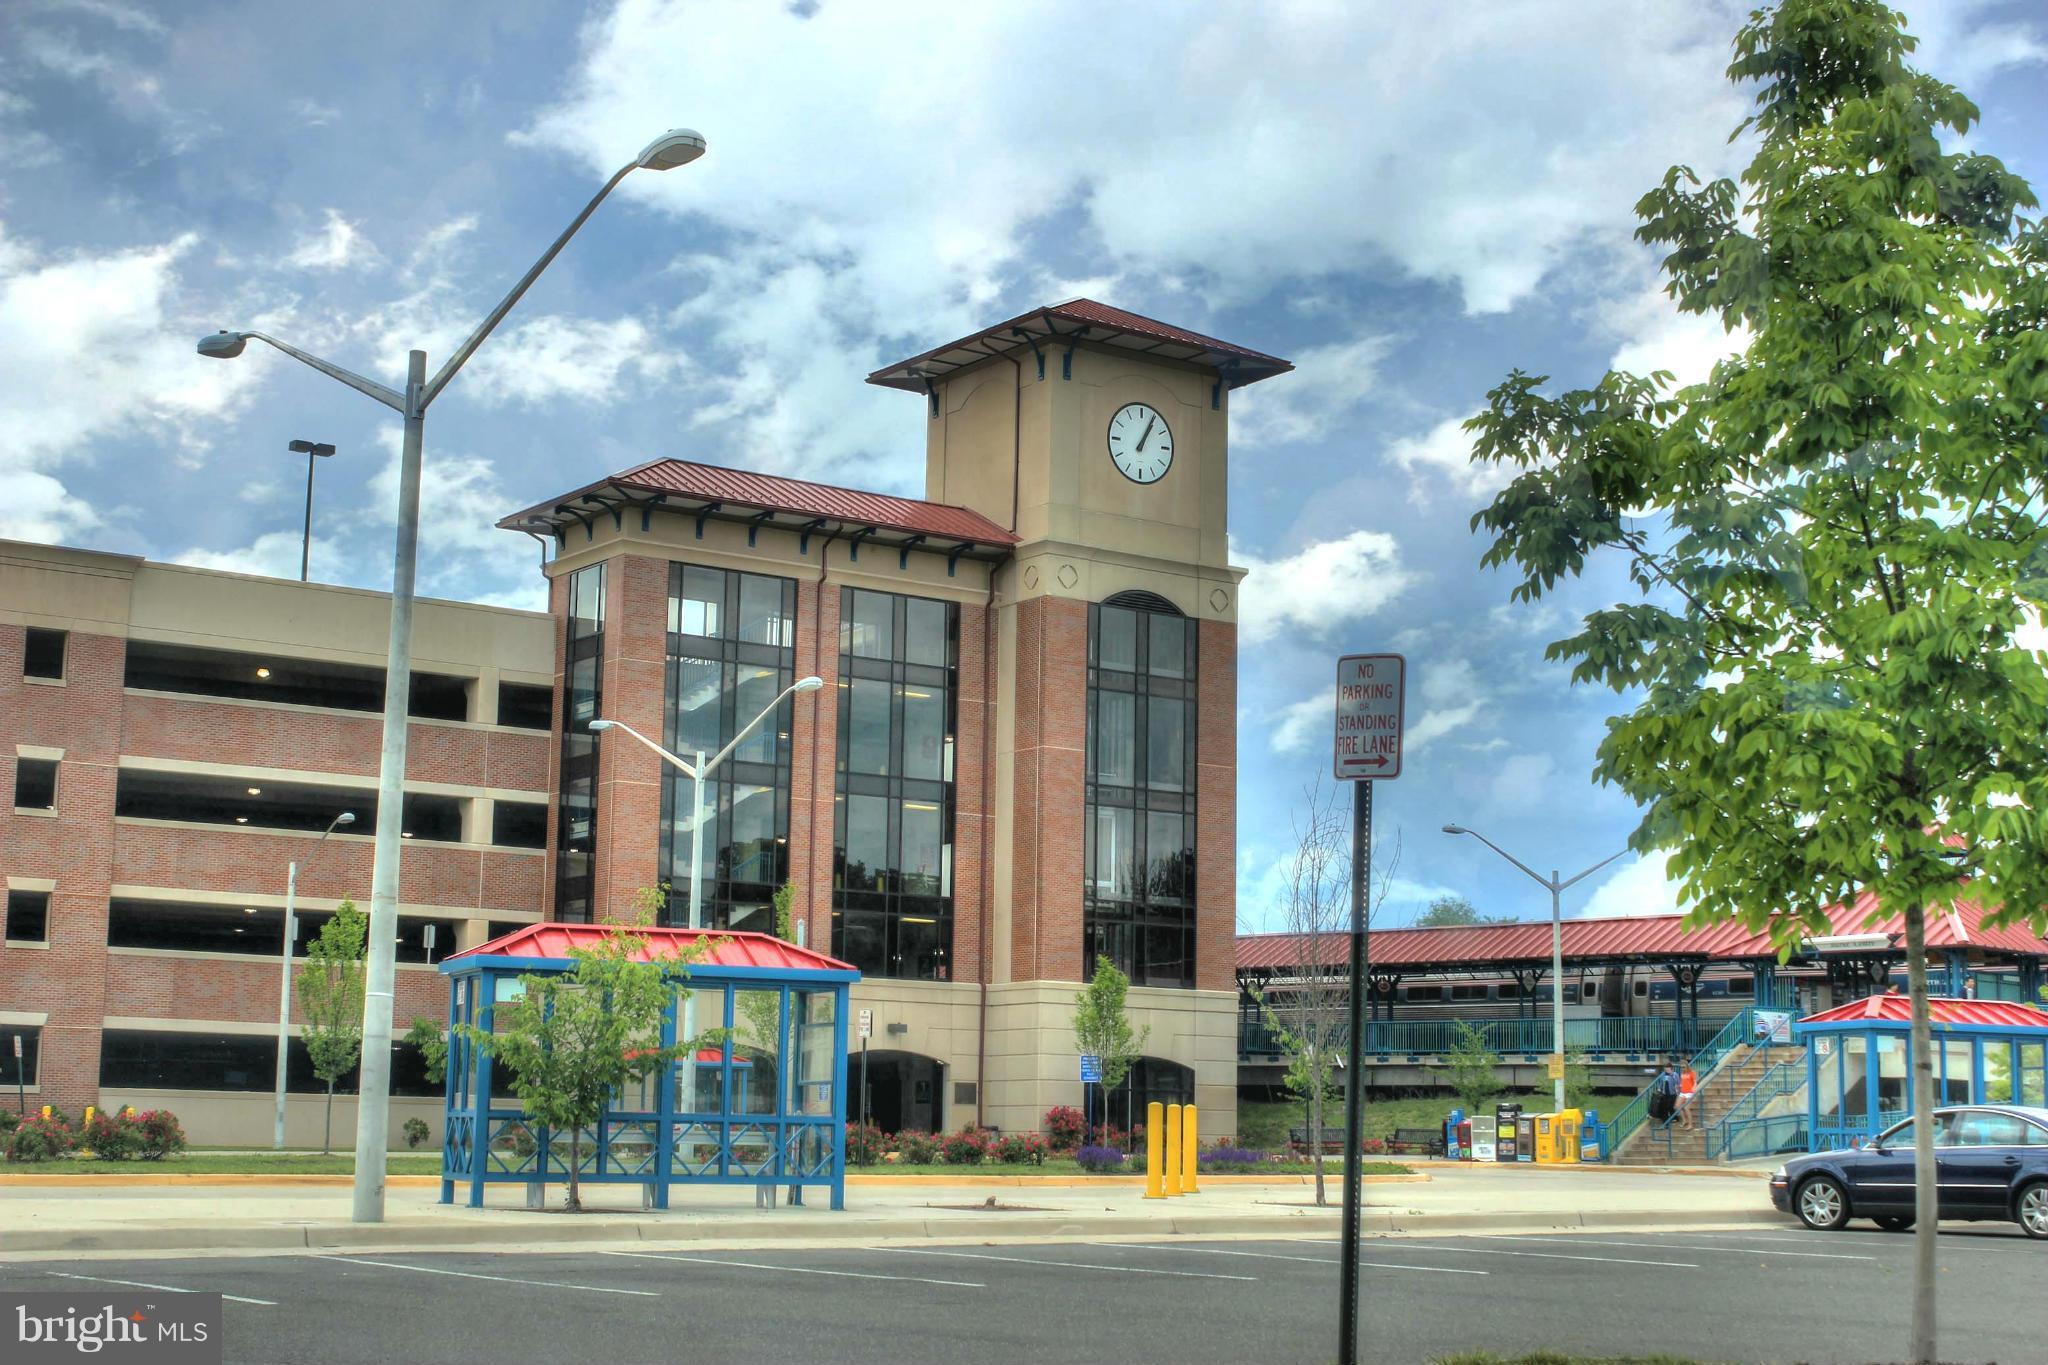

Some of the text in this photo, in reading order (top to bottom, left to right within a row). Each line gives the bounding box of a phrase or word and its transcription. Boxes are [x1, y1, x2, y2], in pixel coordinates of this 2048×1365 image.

[1358, 663, 1374, 679] NO
[1342, 683, 1393, 701] PARKING
[1359, 703, 1370, 711] OR
[1339, 714, 1396, 731] STANDING
[1338, 735, 1396, 755] FIRE LANE
